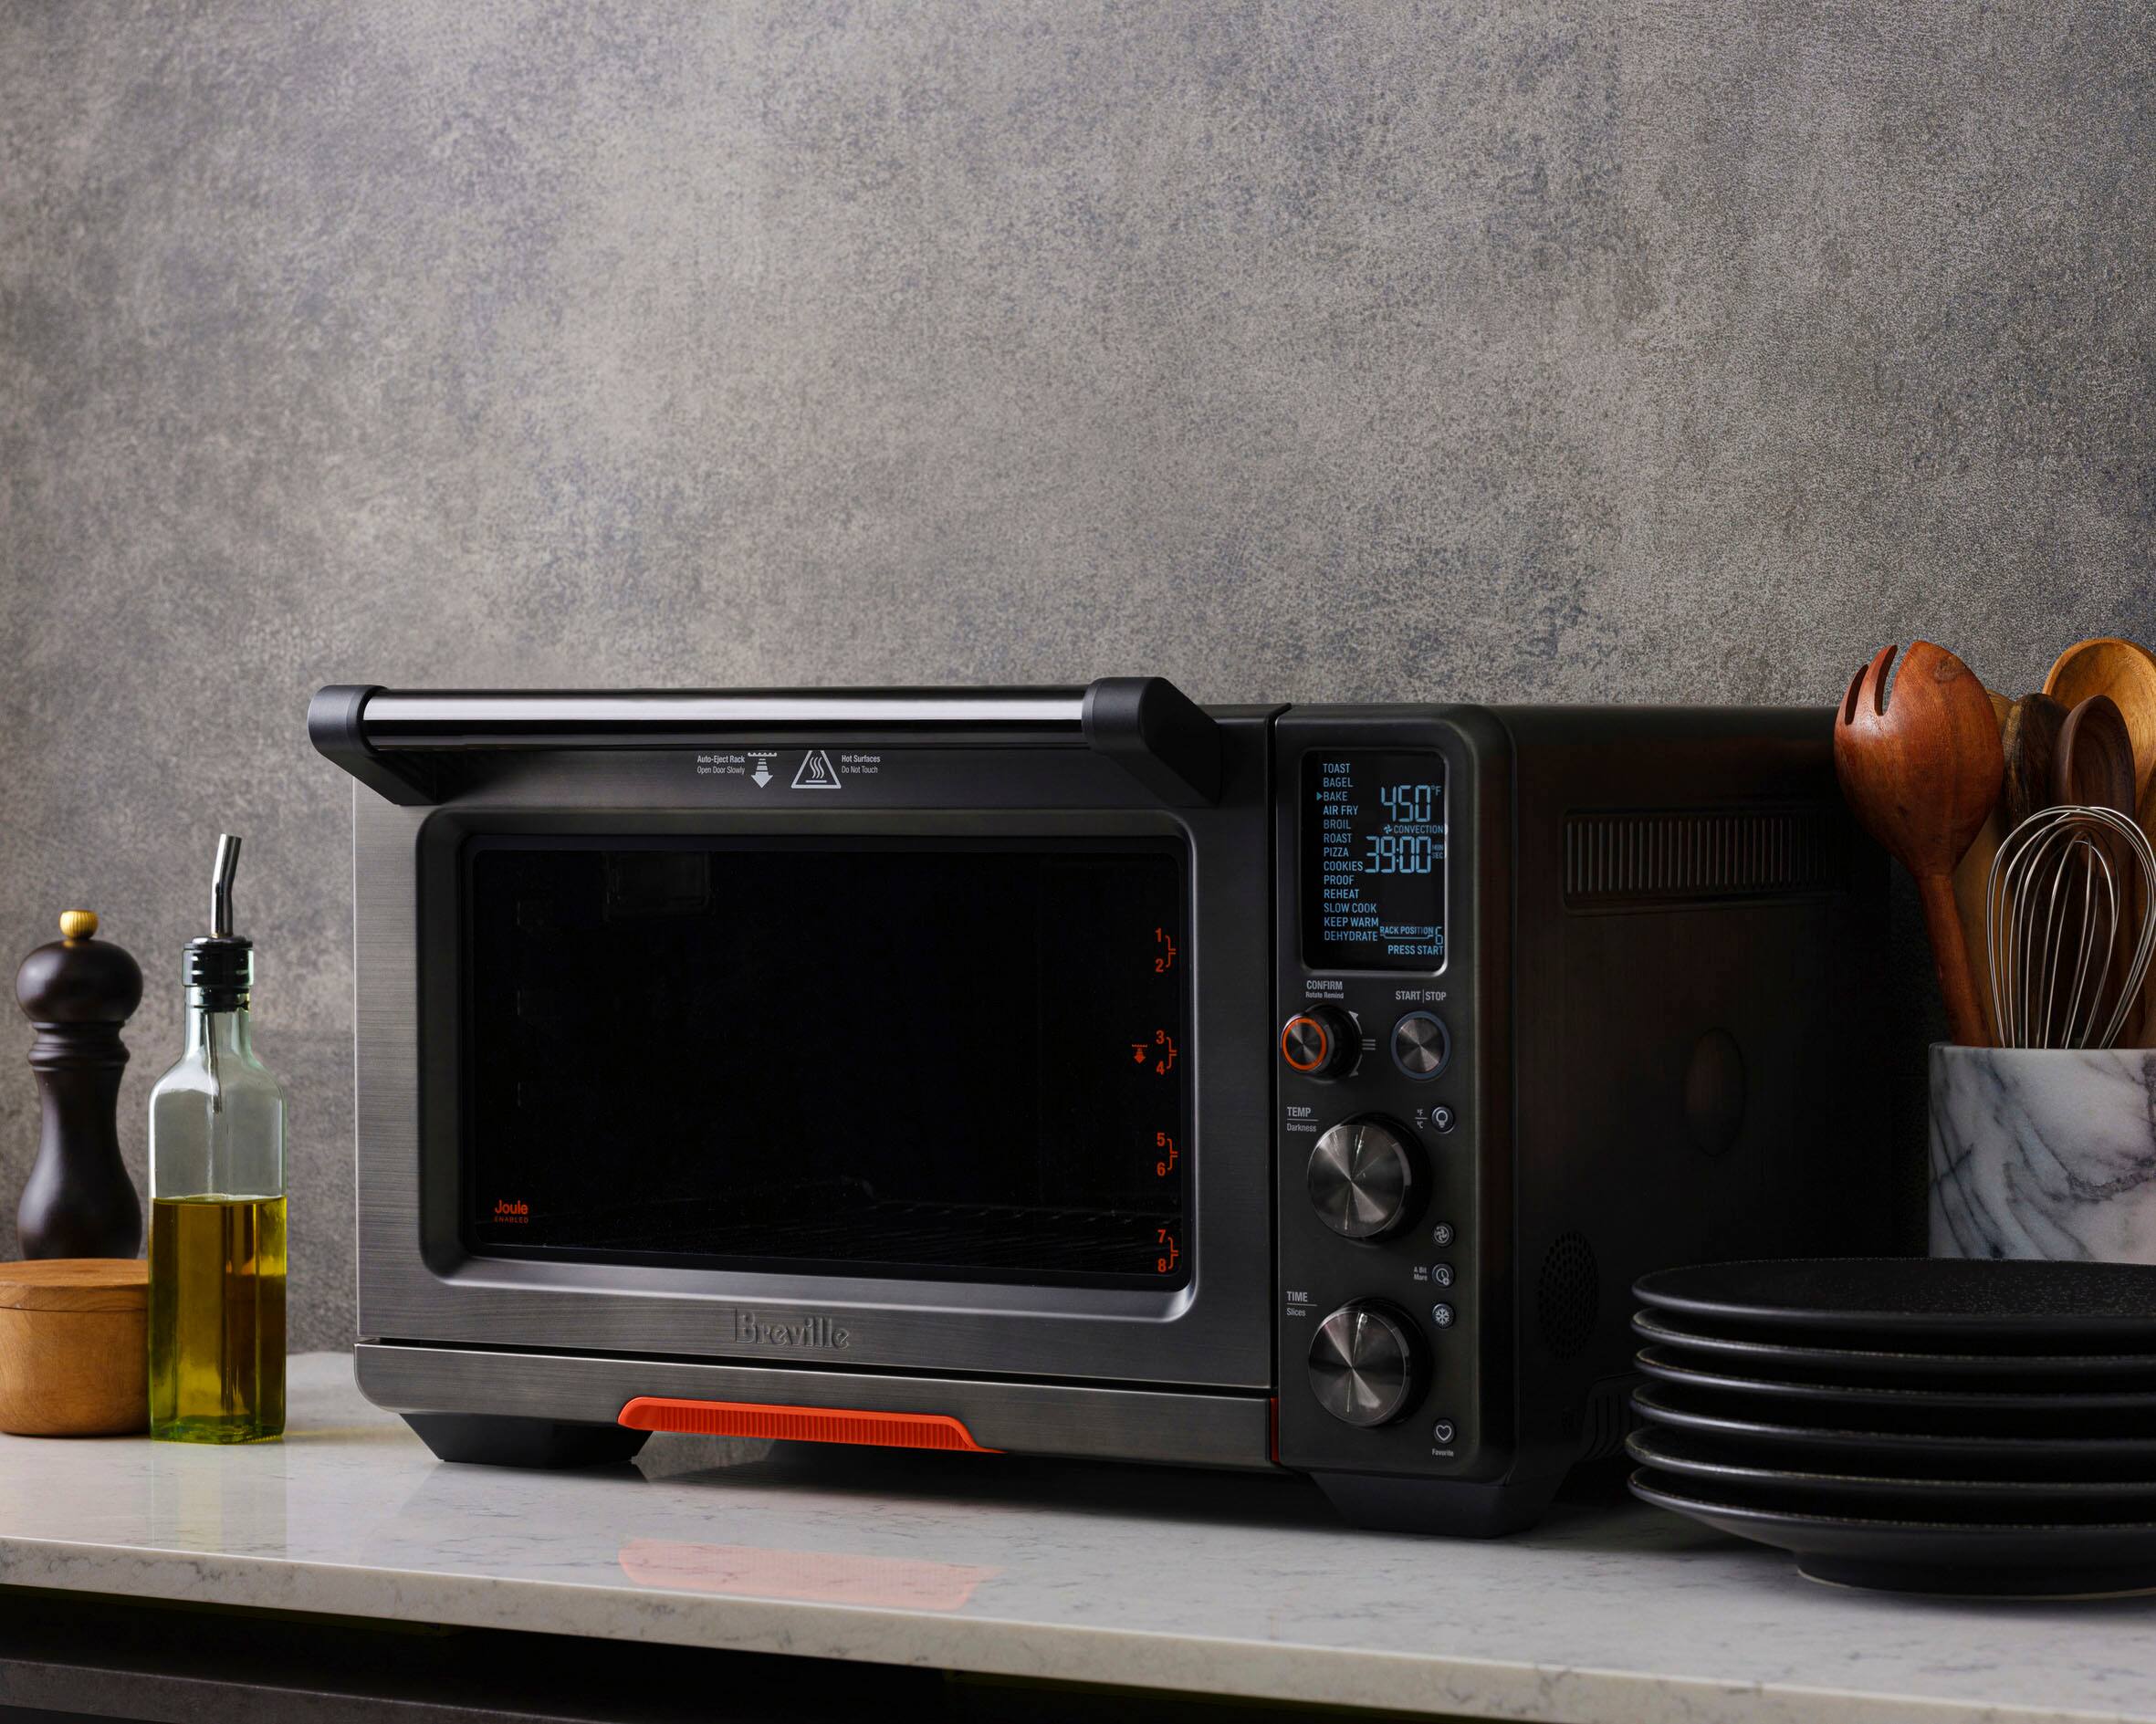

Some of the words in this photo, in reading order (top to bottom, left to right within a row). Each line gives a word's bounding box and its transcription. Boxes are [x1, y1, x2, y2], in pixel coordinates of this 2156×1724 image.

[696, 755, 728, 765] Auto-Eject
[729, 755, 746, 764] Rack
[842, 755, 852, 763] Hot
[853, 755, 881, 763] Surfaces
[696, 766, 712, 775] Open
[713, 766, 726, 774] Door
[727, 766, 746, 775] Slowly
[842, 766, 849, 774] Do
[851, 766, 860, 774] Not
[861, 766, 878, 774] Touch
[1323, 763, 1350, 774] TOAST
[1324, 778, 1353, 788] BAGEL
[1324, 791, 1348, 801] BAKE
[1380, 785, 1431, 822] 450
[1323, 805, 1338, 815] AIR
[1341, 805, 1358, 815] FRY
[1324, 819, 1351, 830] BROIL
[1393, 824, 1444, 834] CONVECTION
[1324, 833, 1352, 843] ROAST
[1324, 847, 1349, 857] PIZZA
[1365, 836, 1431, 873] 39:00
[1324, 861, 1364, 872] COOKIES
[1324, 875, 1355, 885] PROOF
[1324, 889, 1360, 899] REHEAT
[1324, 903, 1349, 913] SLOW
[1352, 903, 1377, 913] COOK
[1324, 917, 1348, 926] KEEP
[1351, 916, 1378, 926] WARM
[1155, 927, 1162, 943] 1
[1324, 931, 1378, 941] DEHYDRATE
[1379, 925, 1398, 935] RACK
[1400, 925, 1434, 935] POSITION
[1435, 926, 1443, 945] 6
[1387, 945, 1416, 955] PRESS
[1417, 946, 1444, 956] START
[1155, 958, 1164, 973] 2
[1306, 980, 1343, 990] CONFIRM
[1156, 1029, 1165, 1045] 3
[1156, 1061, 1165, 1075] 4
[1287, 1106, 1312, 1117] TEMP
[1286, 1123, 1316, 1133] Darkness
[1156, 1133, 1166, 1147] 5
[1156, 1162, 1166, 1176] 6
[495, 1199, 529, 1215] Joule
[495, 1216, 529, 1224] ENABLED
[1157, 1229, 1167, 1244] 7
[1157, 1259, 1167, 1273] 8
[1286, 1291, 1308, 1302] TIME
[1286, 1308, 1306, 1317] Slices
[735, 1307, 851, 1350] Breville
[1431, 1448, 1454, 1457] Favorite
